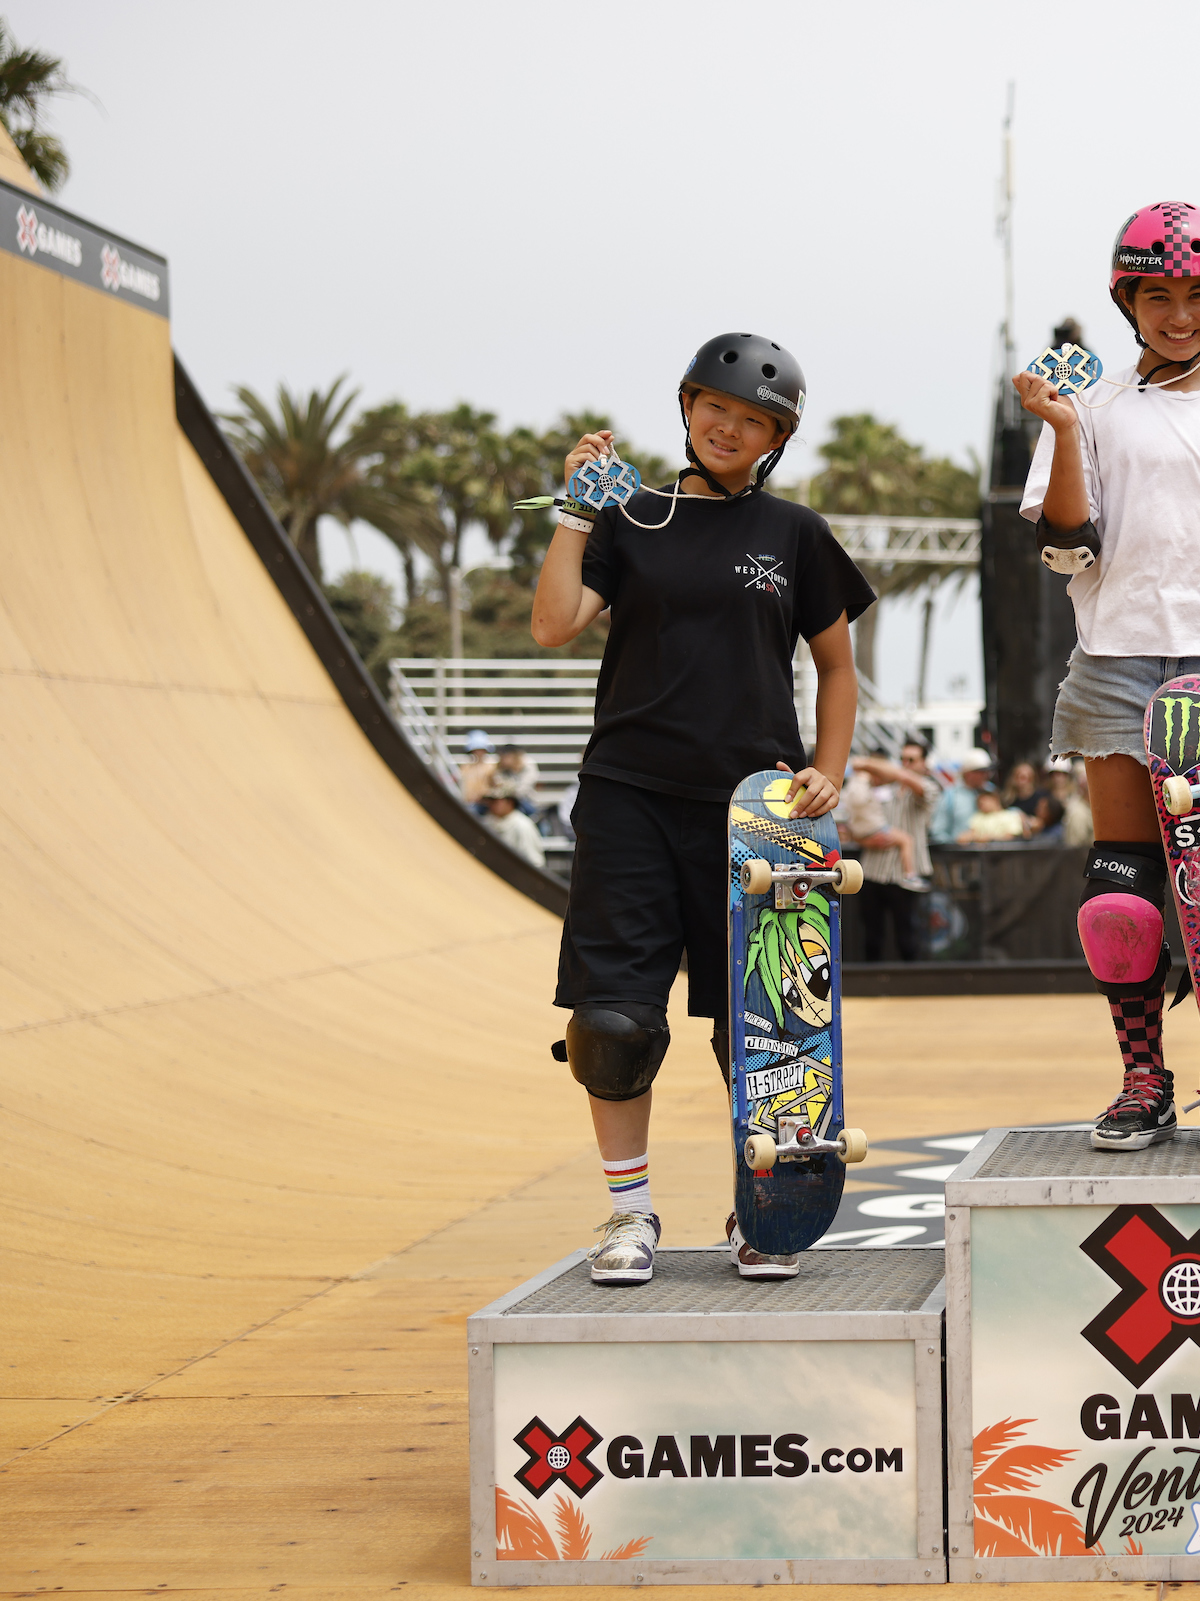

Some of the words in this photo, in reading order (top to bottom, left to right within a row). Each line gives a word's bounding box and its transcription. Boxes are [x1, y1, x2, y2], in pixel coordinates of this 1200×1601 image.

[37, 222, 82, 267] GAMES
[1119, 254, 1162, 266] MONSTER
[119, 260, 161, 301] GAMES
[734, 565, 762, 577] WEST
[770, 571, 788, 587] TOKYO
[1118, 1505, 1185, 1538] 2024
